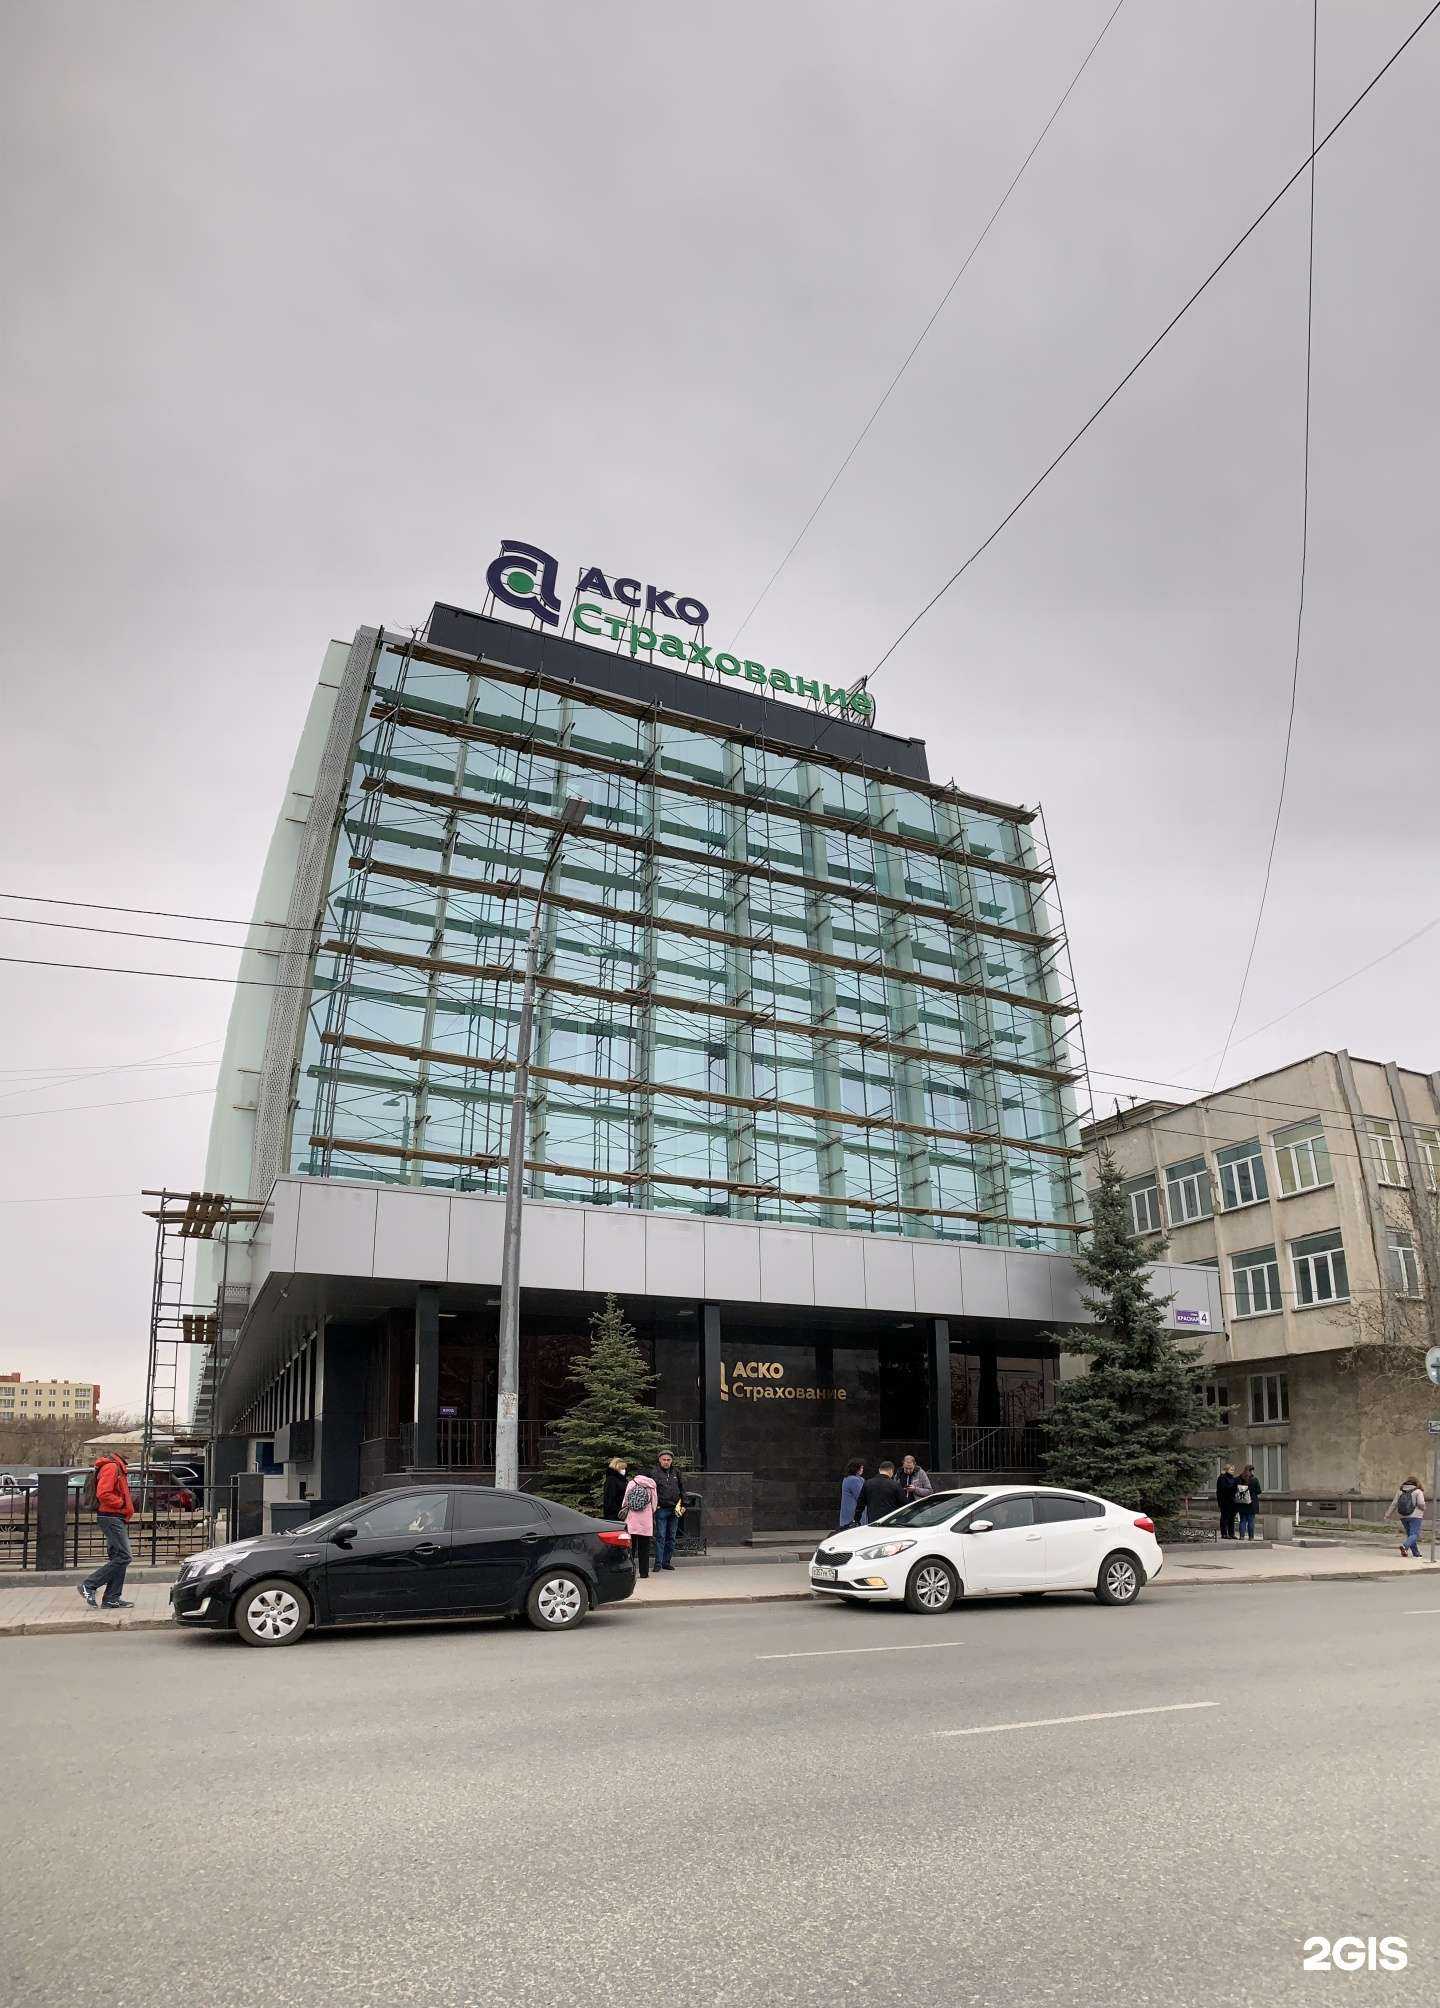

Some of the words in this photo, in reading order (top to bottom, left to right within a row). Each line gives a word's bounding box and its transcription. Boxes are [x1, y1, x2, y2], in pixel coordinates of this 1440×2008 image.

[576, 566, 709, 626] АСКО
[572, 603, 872, 715] Страхование
[1201, 1313, 1207, 1323] 4
[732, 1361, 784, 1379] АСКО
[732, 1381, 848, 1402] Страхование
